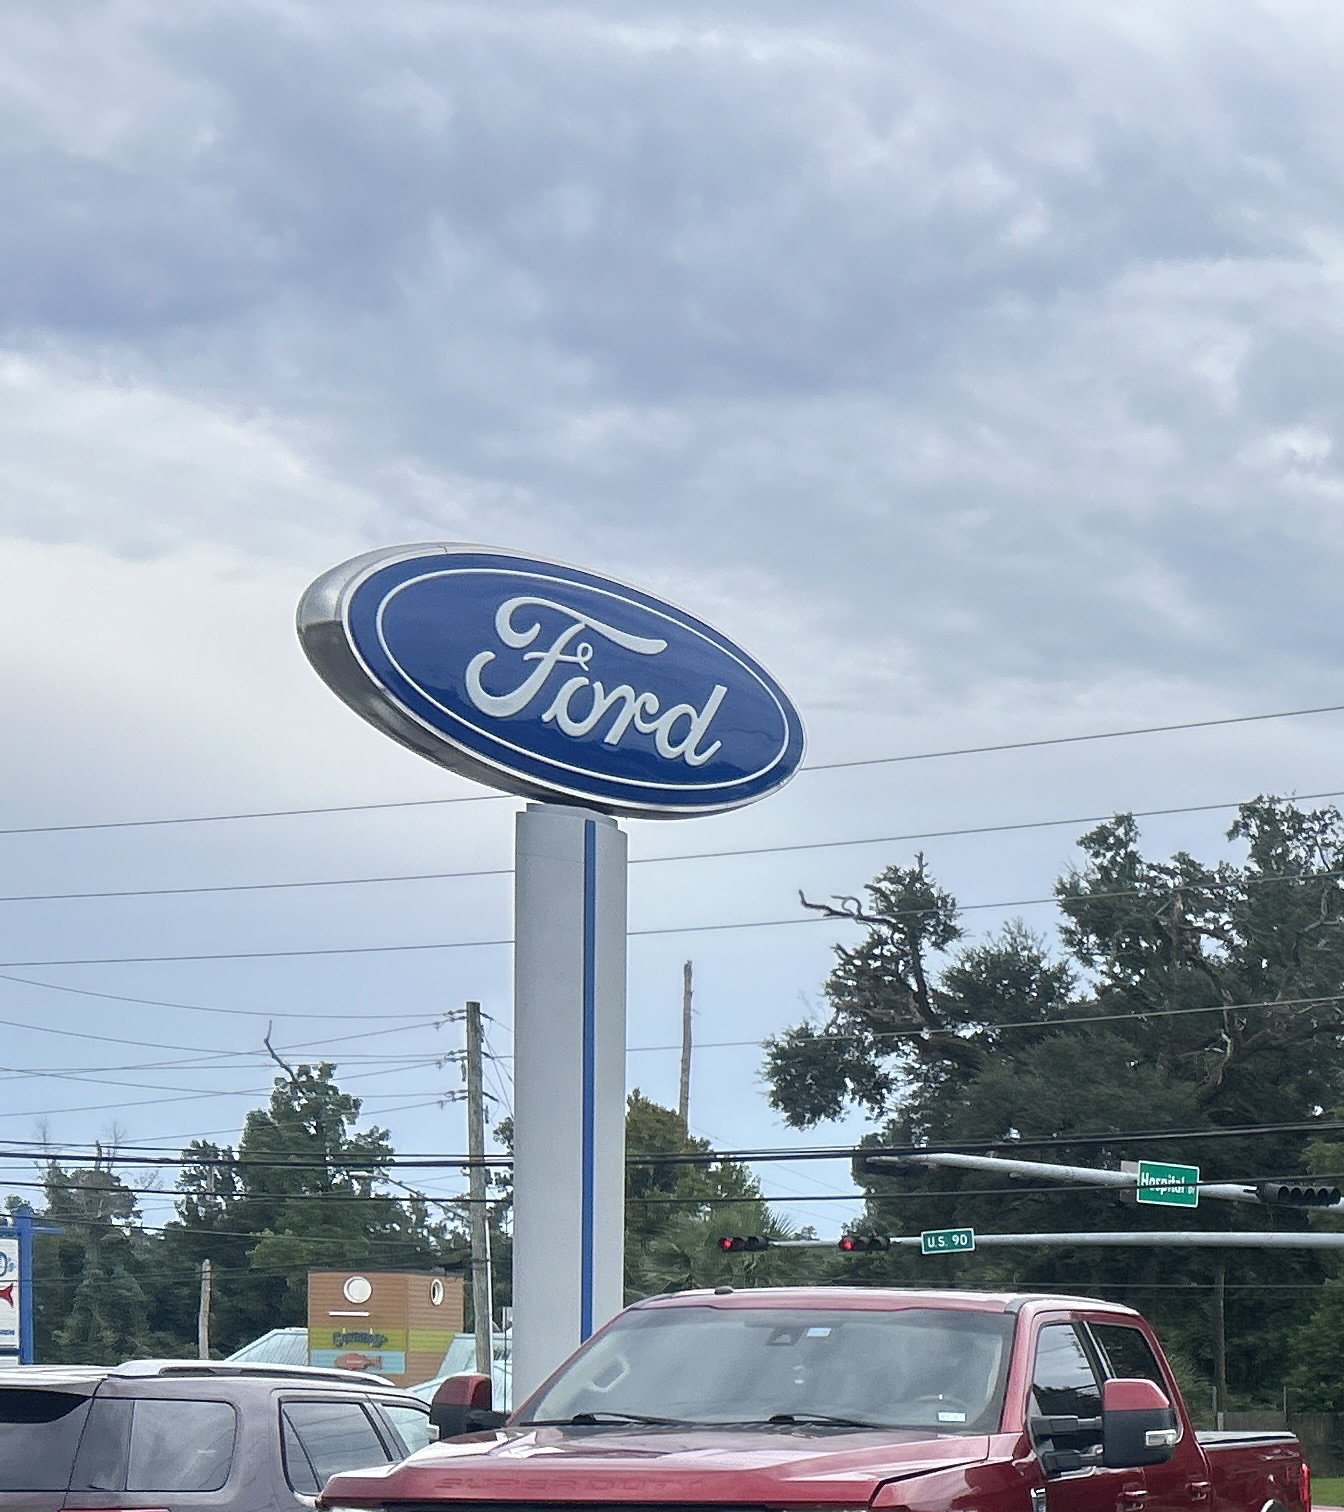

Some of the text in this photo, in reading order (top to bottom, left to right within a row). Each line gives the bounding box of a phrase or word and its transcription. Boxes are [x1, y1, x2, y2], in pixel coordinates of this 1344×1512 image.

[465, 595, 729, 768] Ford
[1140, 1172, 1185, 1196] Hospital
[927, 1233, 968, 1248] U.S. 90
[434, 1478, 577, 1490] SUPER
